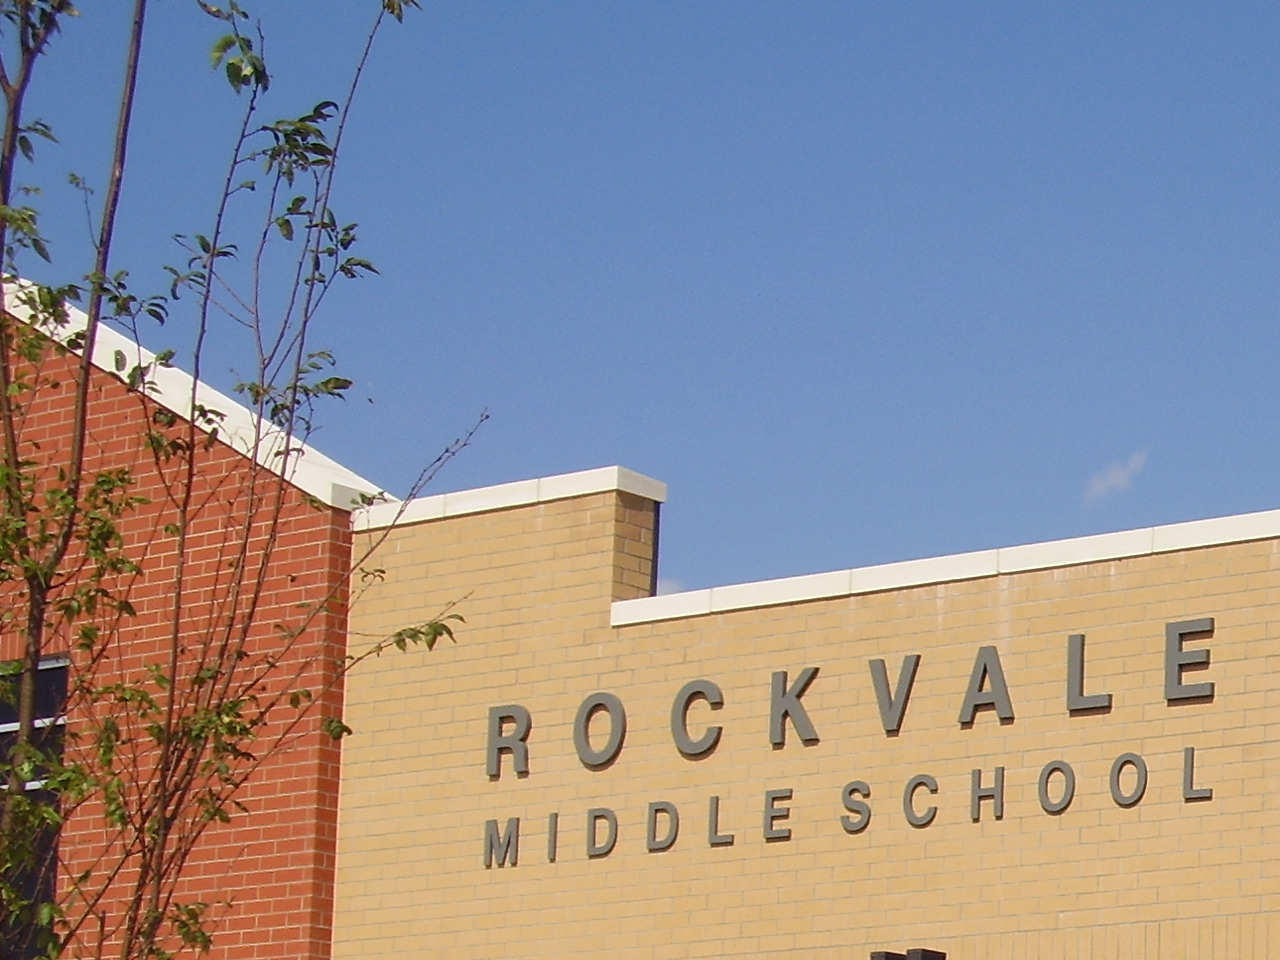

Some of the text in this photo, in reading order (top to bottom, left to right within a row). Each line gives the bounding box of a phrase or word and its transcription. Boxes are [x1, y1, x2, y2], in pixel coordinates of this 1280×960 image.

[486, 617, 1216, 781] ROCKVALE
[484, 746, 1214, 869] MIDDLE SCHOOL
